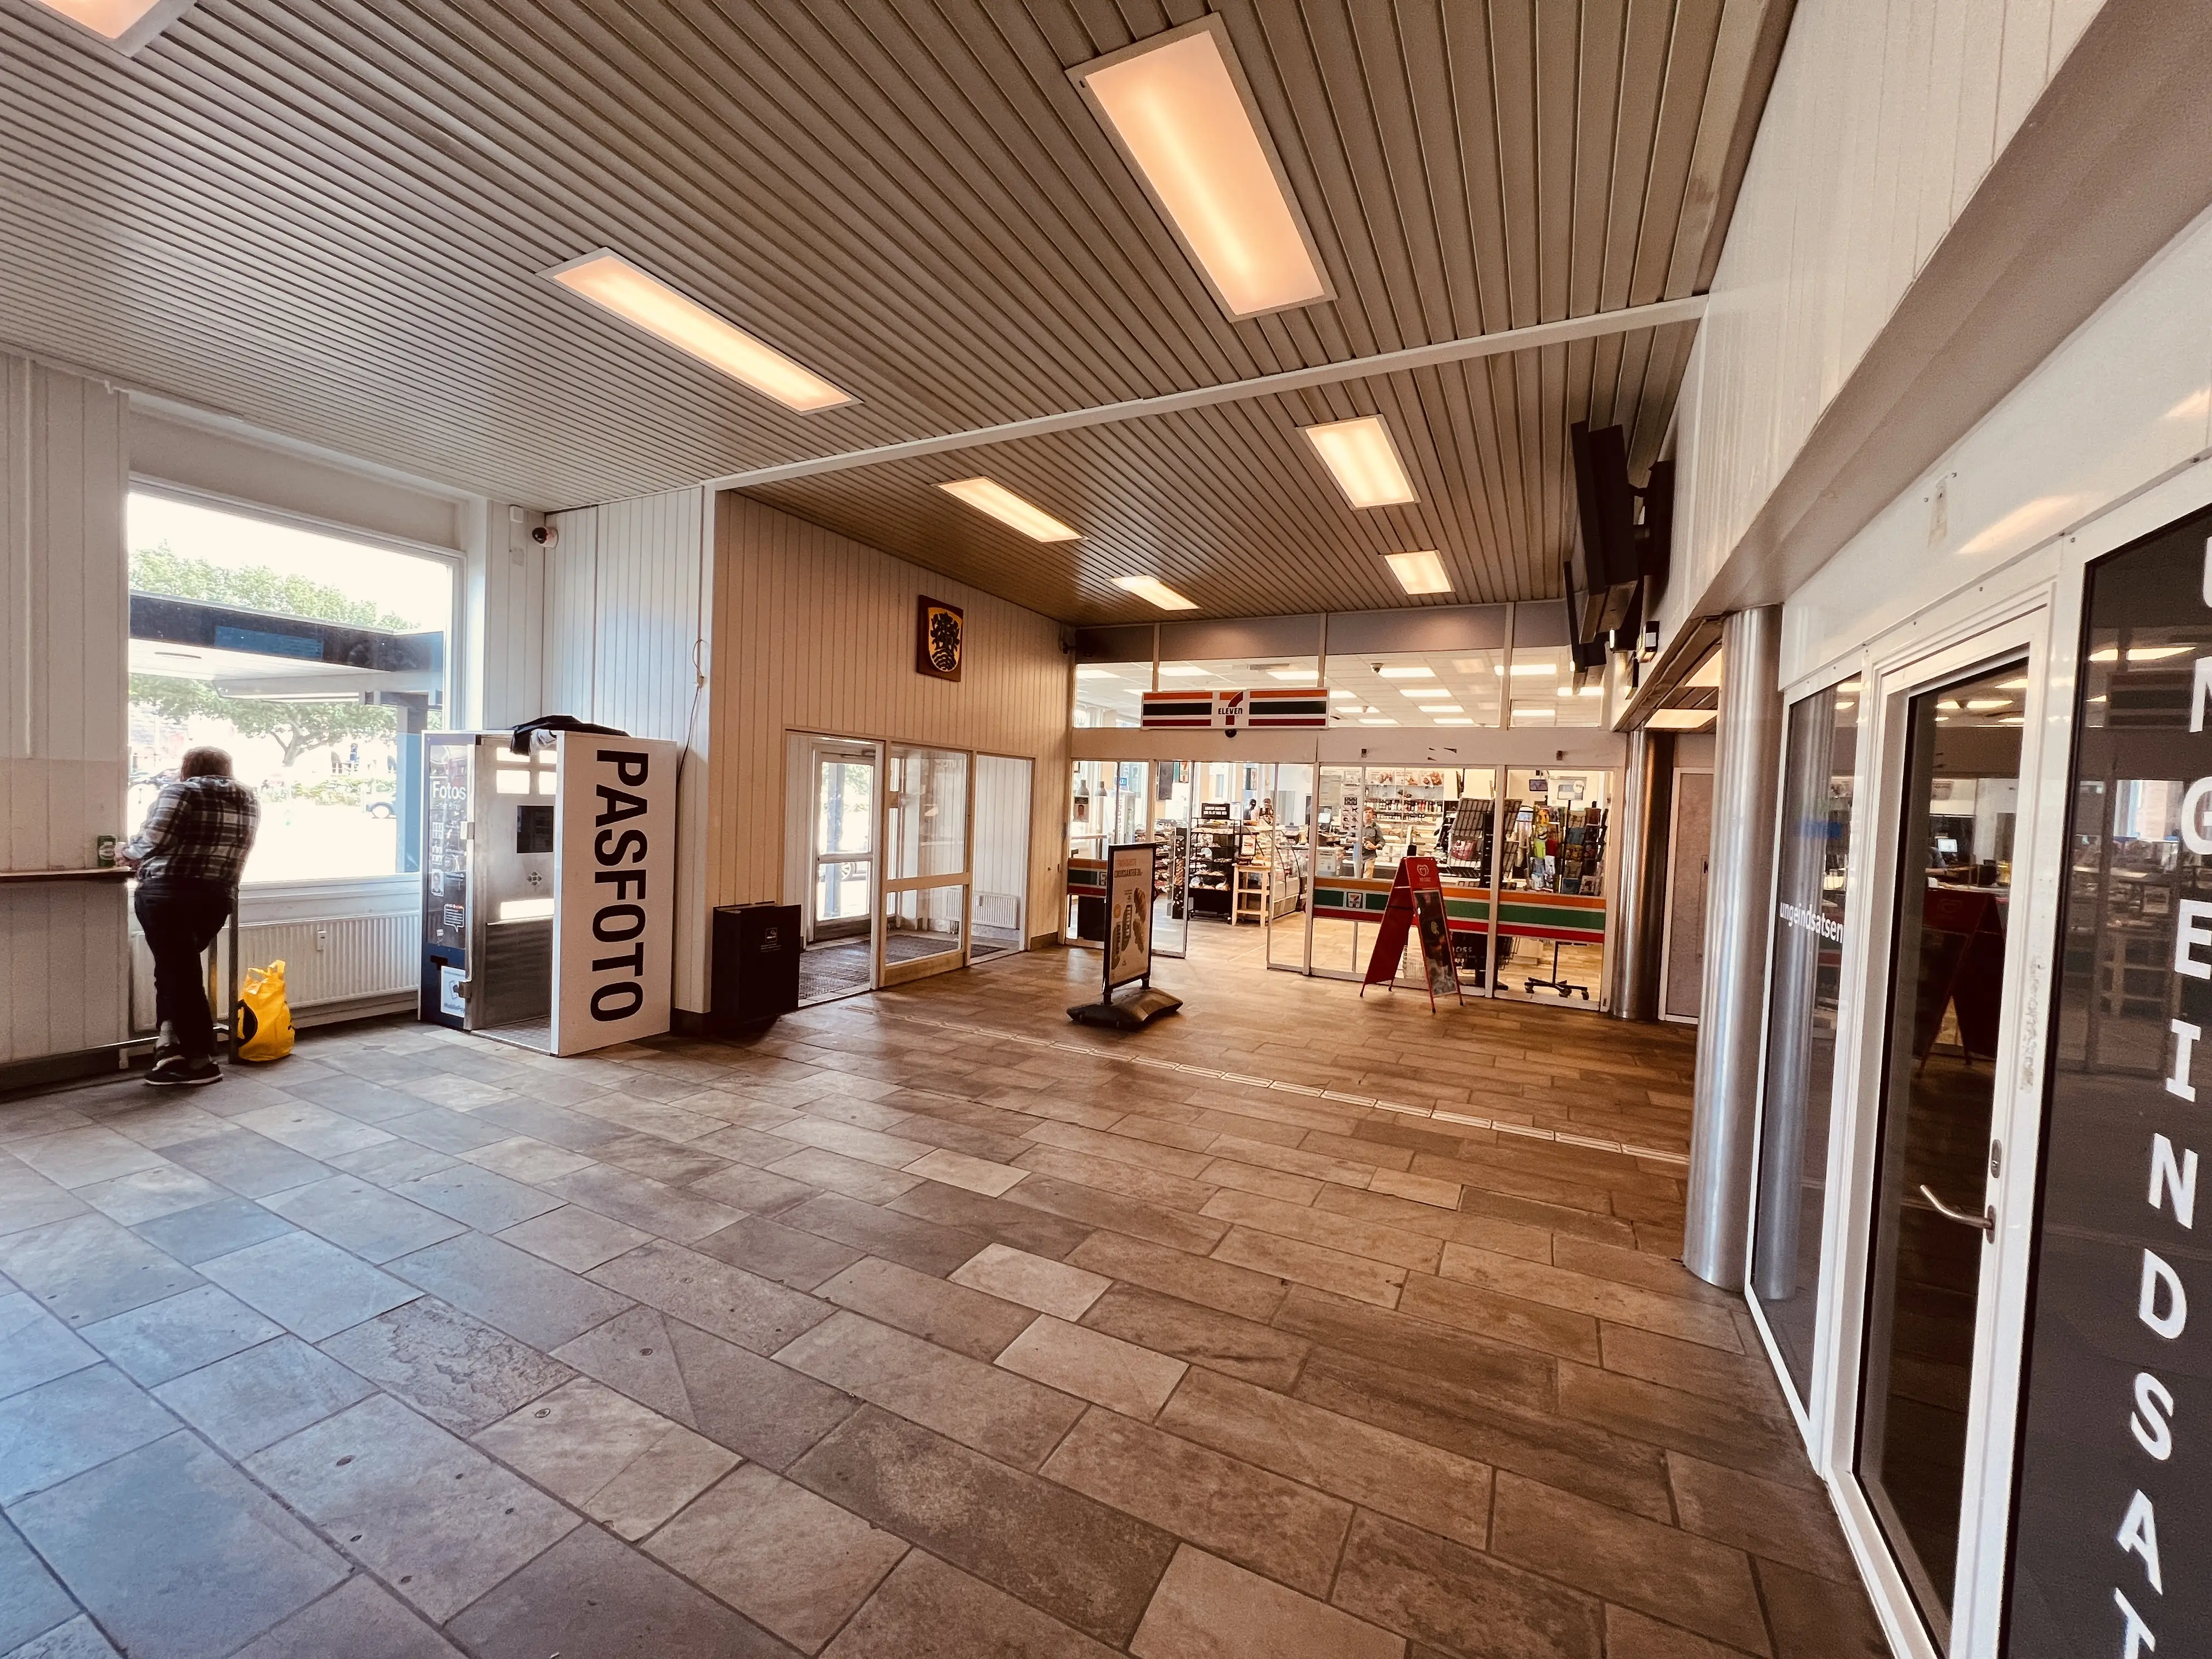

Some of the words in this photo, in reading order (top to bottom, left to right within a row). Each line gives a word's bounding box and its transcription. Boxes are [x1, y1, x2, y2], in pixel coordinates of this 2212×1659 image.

[432, 781, 467, 800] Fotos
[590, 749, 649, 1022] PASFOTO
[1780, 902, 1844, 944] ungeindsatsen
[2113, 537, 2212, 1659] GEINDSAT
